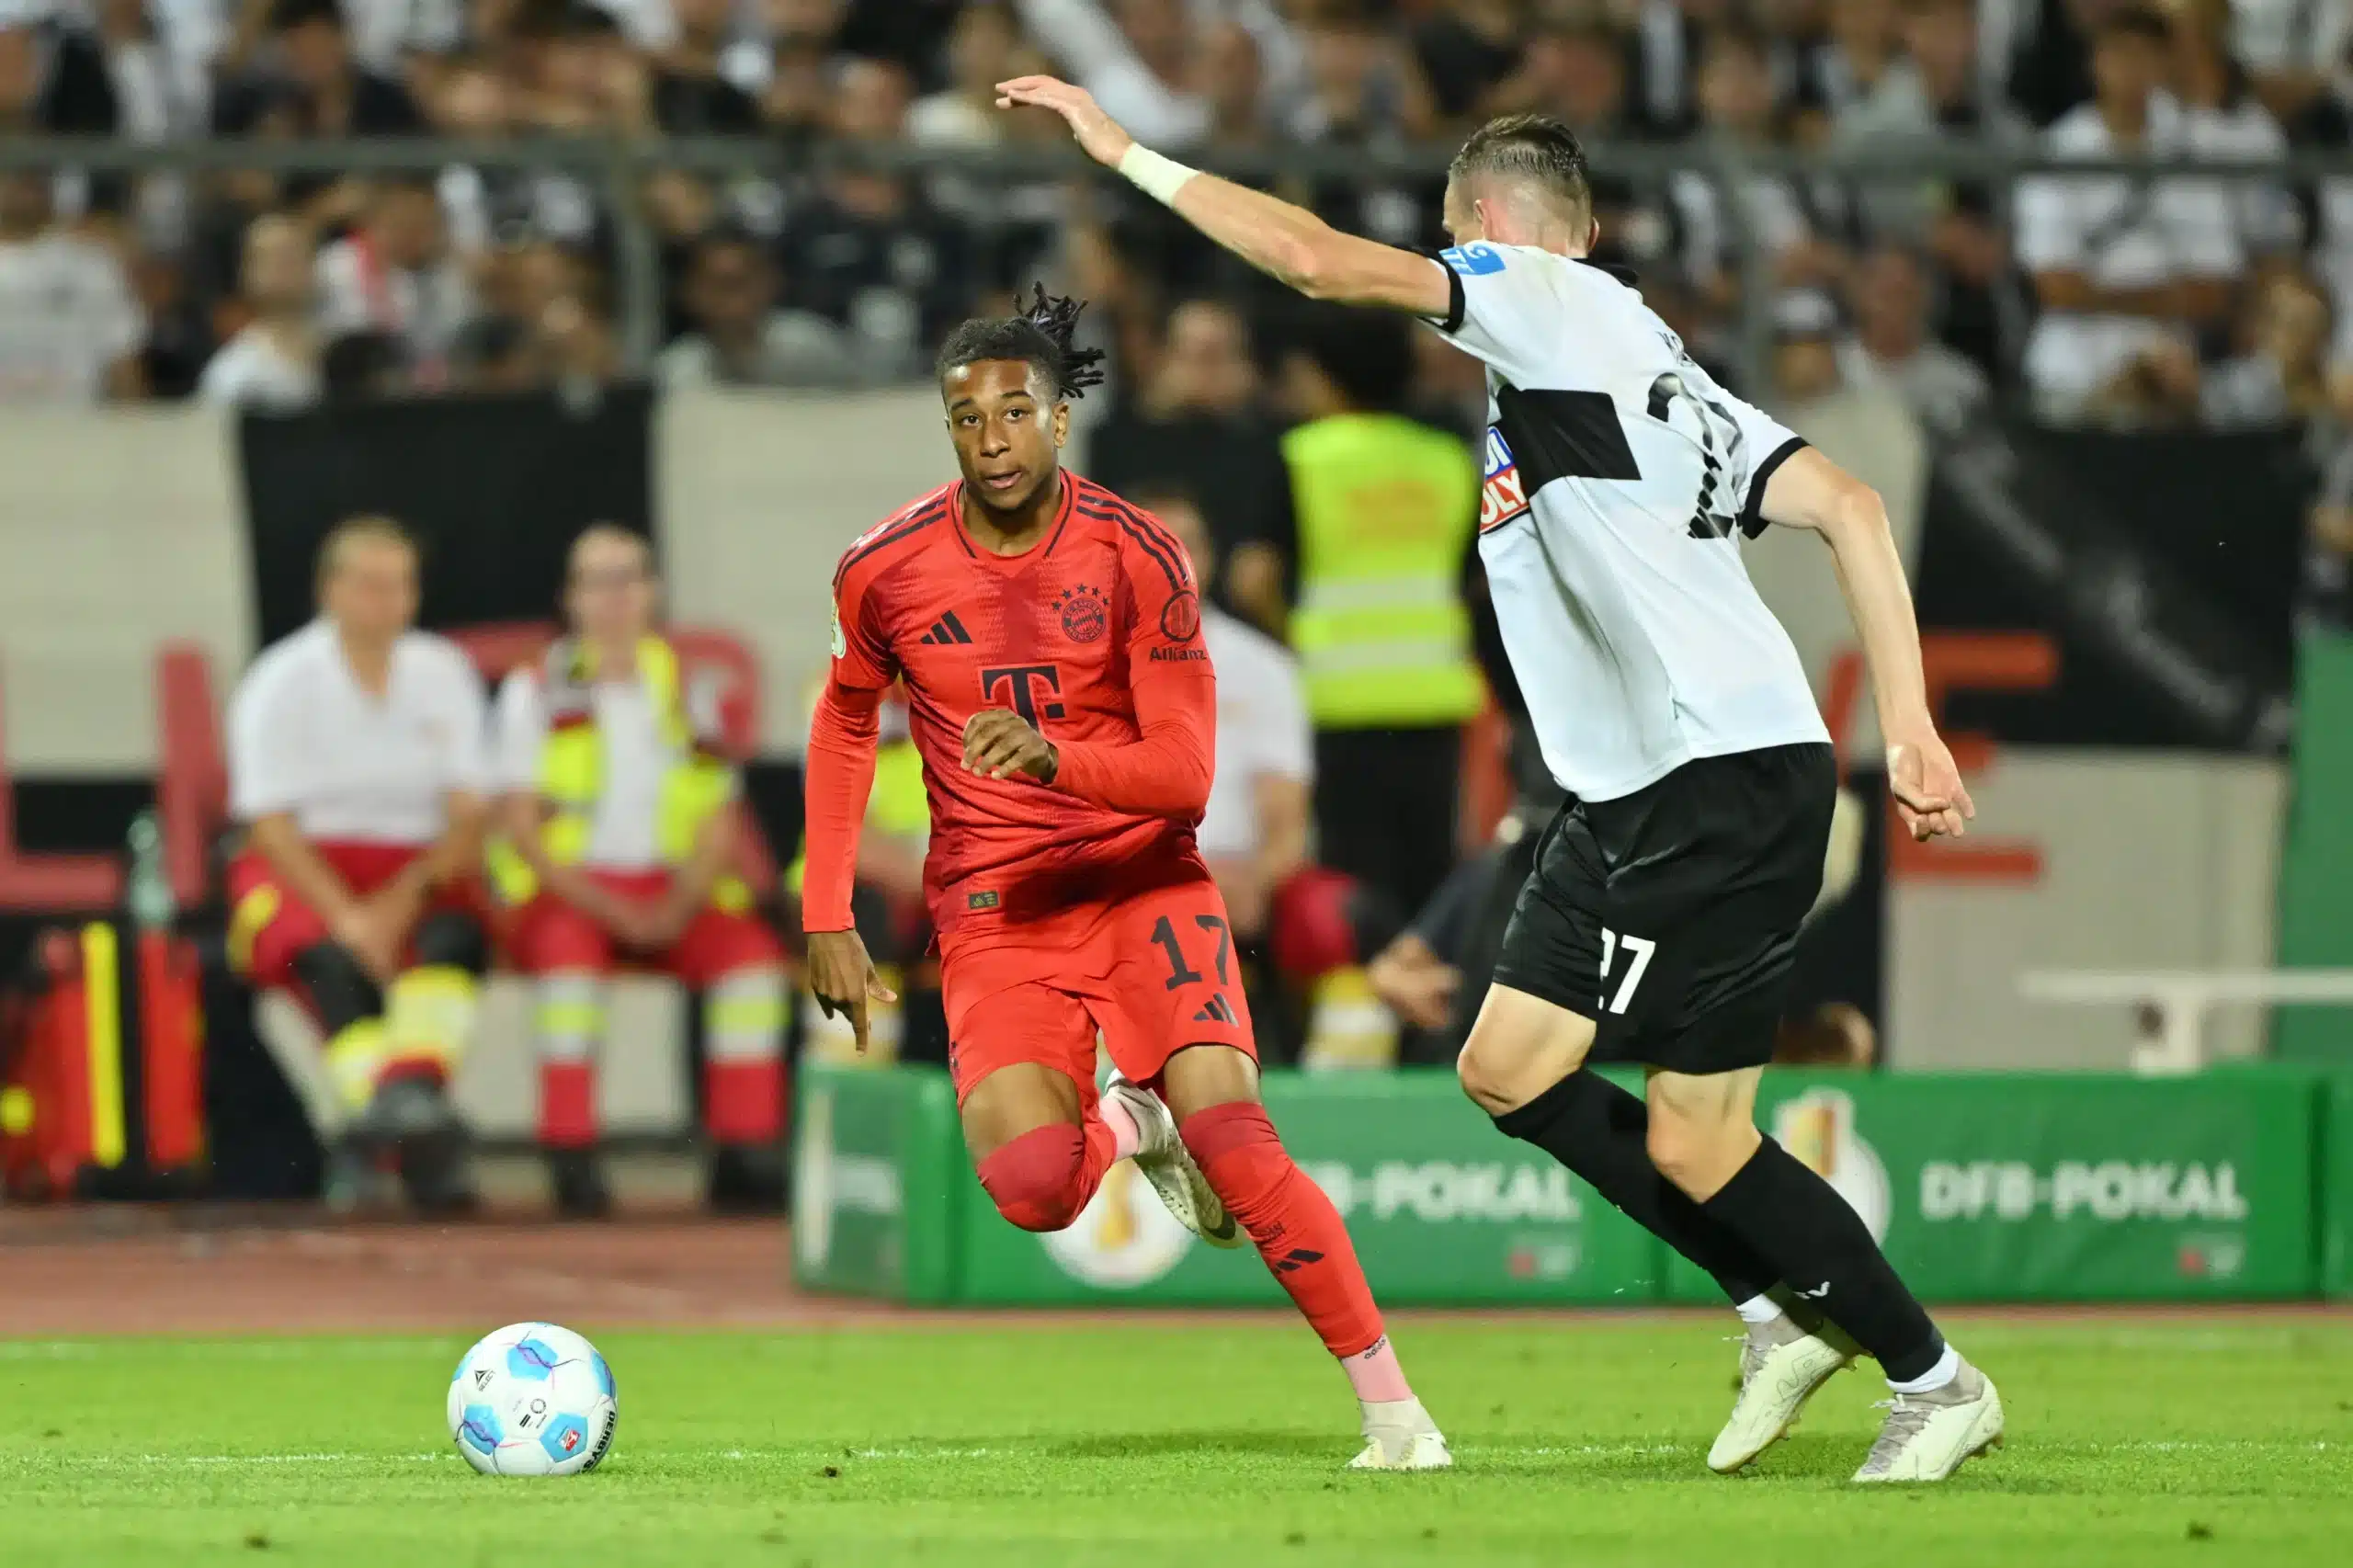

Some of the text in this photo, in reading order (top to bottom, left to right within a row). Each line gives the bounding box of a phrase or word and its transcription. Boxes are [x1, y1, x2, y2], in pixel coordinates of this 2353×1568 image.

[1480, 468, 1528, 524] OLY
[1149, 646, 1207, 663] Allianz
[1151, 915, 1231, 991] 17
[1297, 1160, 1583, 1222] B-POKAL
[1919, 1160, 2249, 1222] DFB-POKAL
